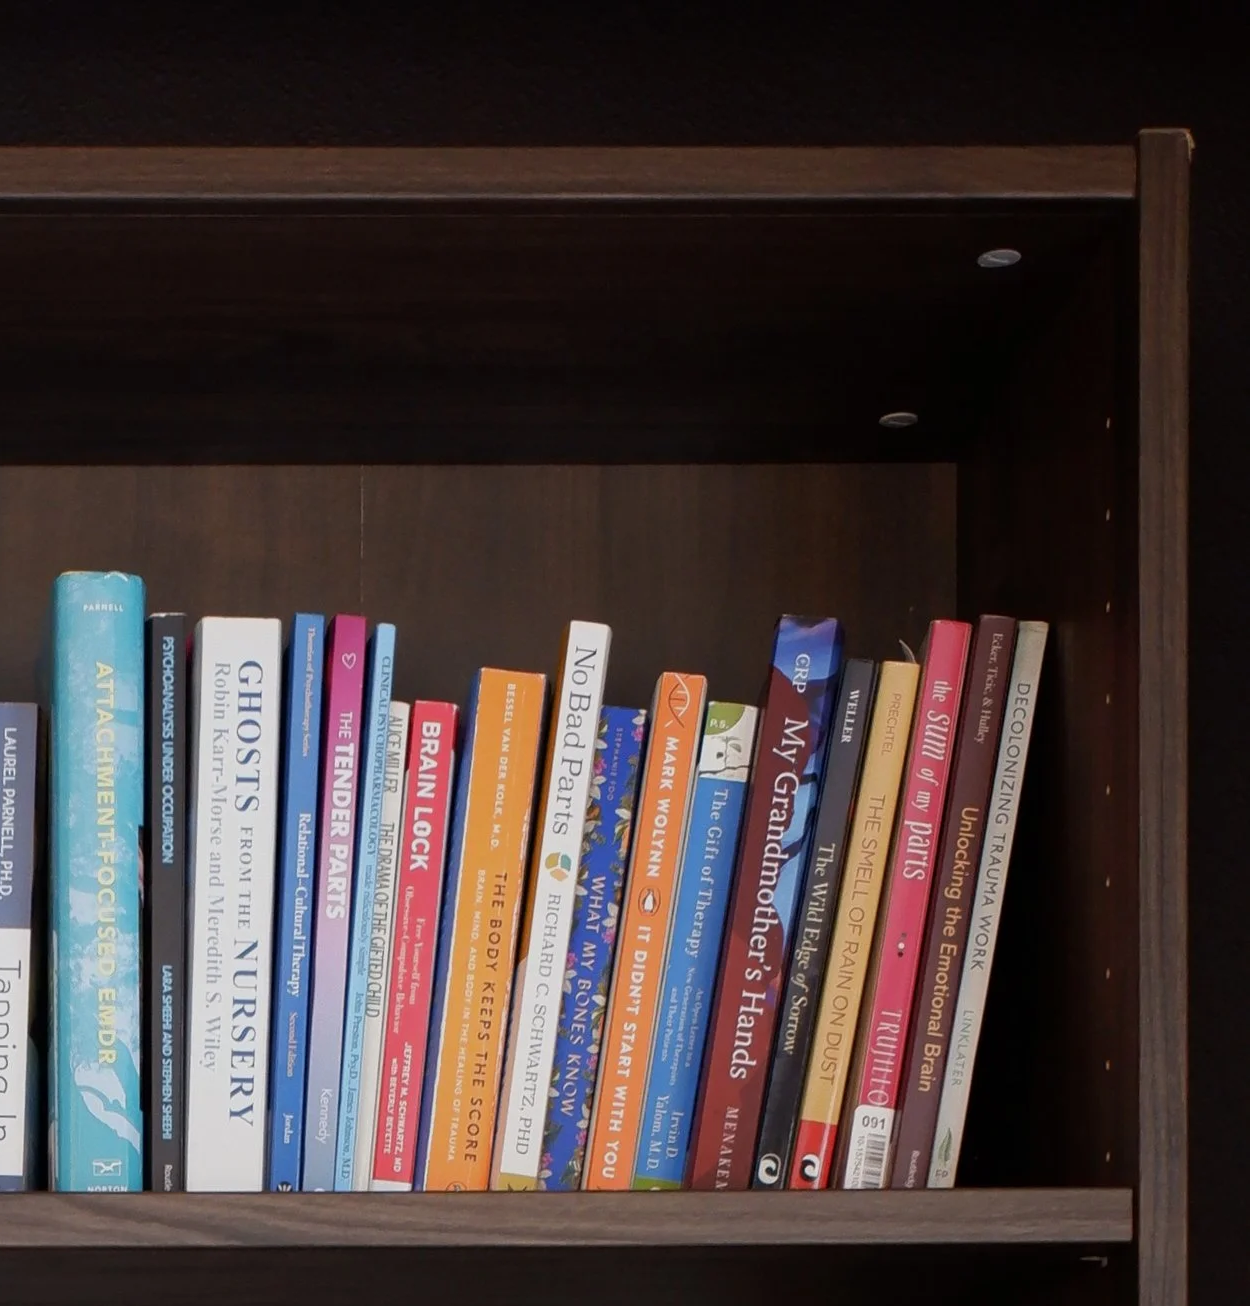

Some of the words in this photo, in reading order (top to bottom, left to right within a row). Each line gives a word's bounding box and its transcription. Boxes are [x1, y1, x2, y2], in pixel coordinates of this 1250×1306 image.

[570, 645, 599, 686] No
[233, 659, 264, 813] GHOSTS
[337, 710, 354, 739] THE
[562, 690, 593, 750] Bad
[771, 716, 810, 764] My
[2, 727, 18, 786] LAUREL
[415, 720, 441, 798] BRAIN
[994, 682, 1032, 825] DECOLONIZING
[328, 742, 355, 838] TENDER
[551, 755, 584, 840] Parts
[238, 826, 254, 882] FROM
[409, 806, 435, 872] LOCK
[980, 832, 1007, 907] TRAUMA
[325, 842, 349, 920] PARTS
[490, 872, 509, 909] THE
[744, 771, 802, 981] Grandmother's
[237, 893, 252, 928] THE
[485, 918, 503, 972] BODY
[969, 914, 993, 971] WORK
[228, 939, 259, 1127] NURSERY
[476, 981, 496, 1041] KEEPS
[729, 989, 767, 1080] Hands
[471, 1051, 489, 1088] THE
[463, 1096, 484, 1163] SCORE
